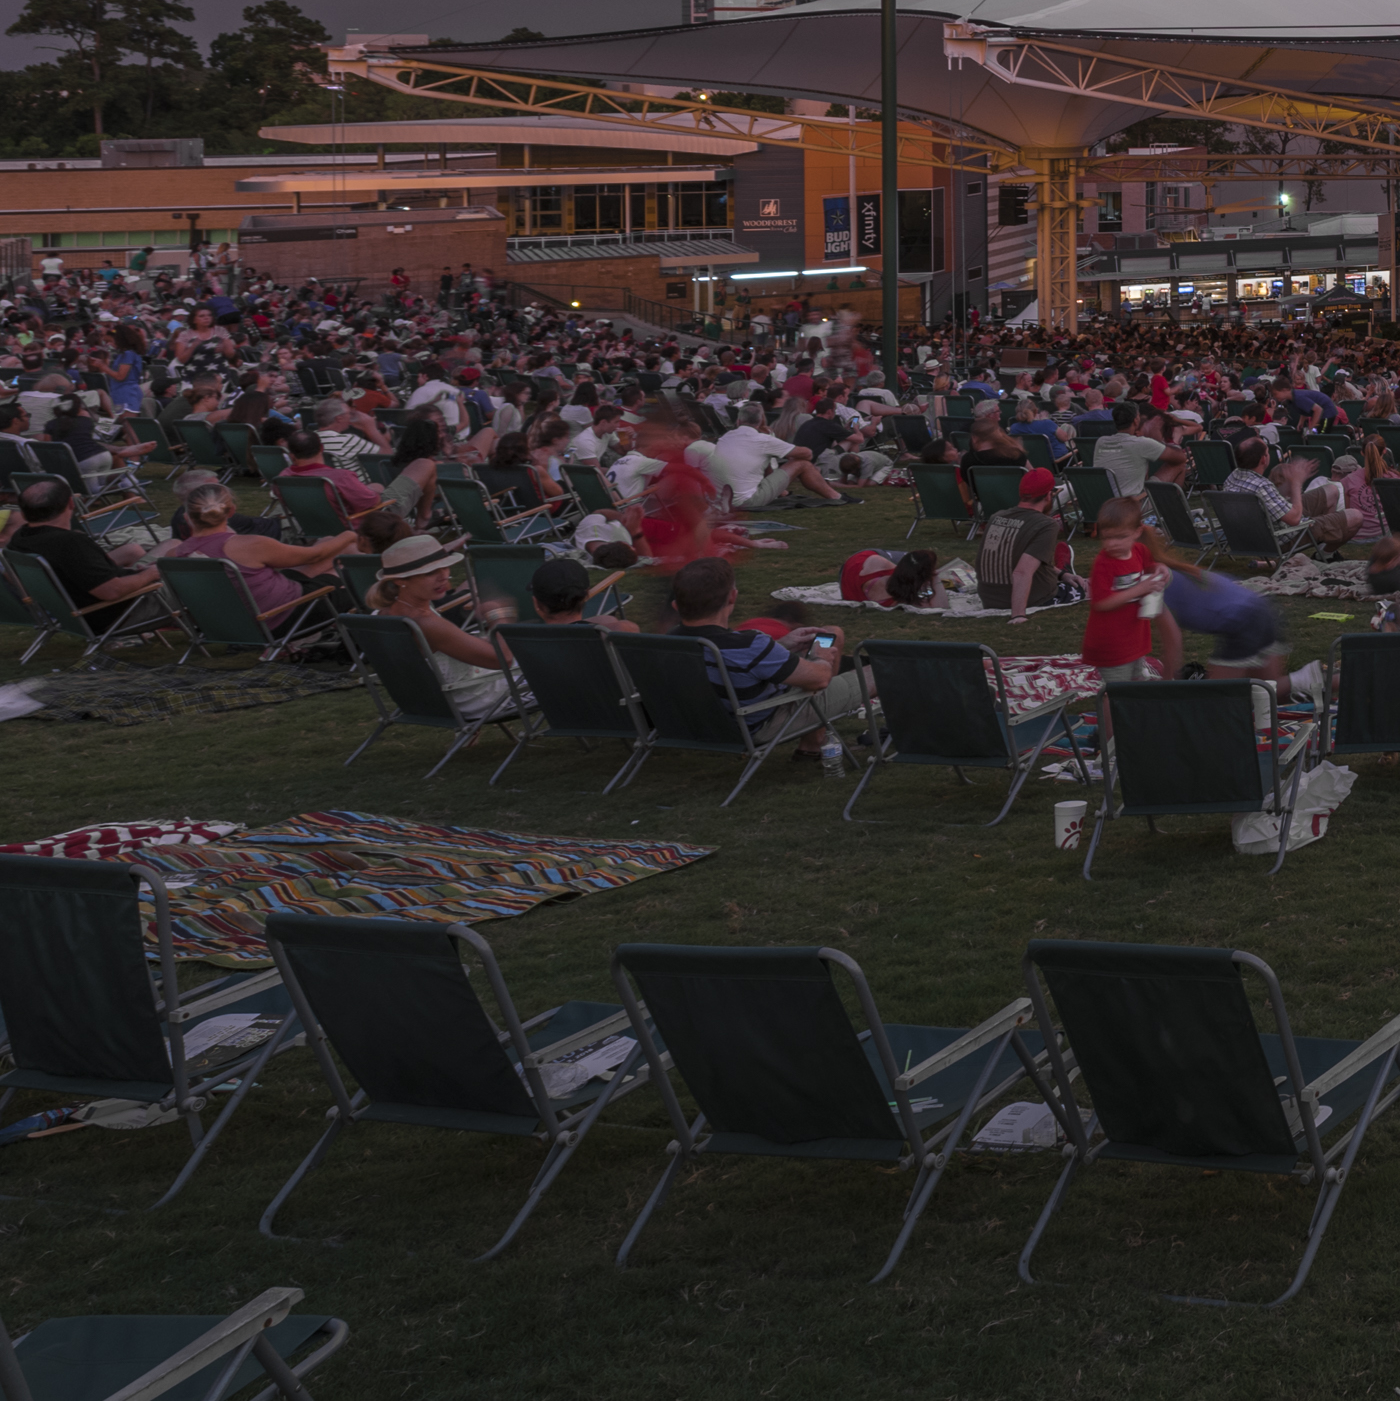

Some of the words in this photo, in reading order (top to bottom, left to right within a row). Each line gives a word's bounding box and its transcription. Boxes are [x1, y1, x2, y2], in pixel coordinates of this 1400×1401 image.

[742, 219, 798, 227] WOODFOREST
[861, 201, 877, 249] xfinity
[826, 230, 850, 243] BUD
[992, 515, 1025, 529] FREEDOM
